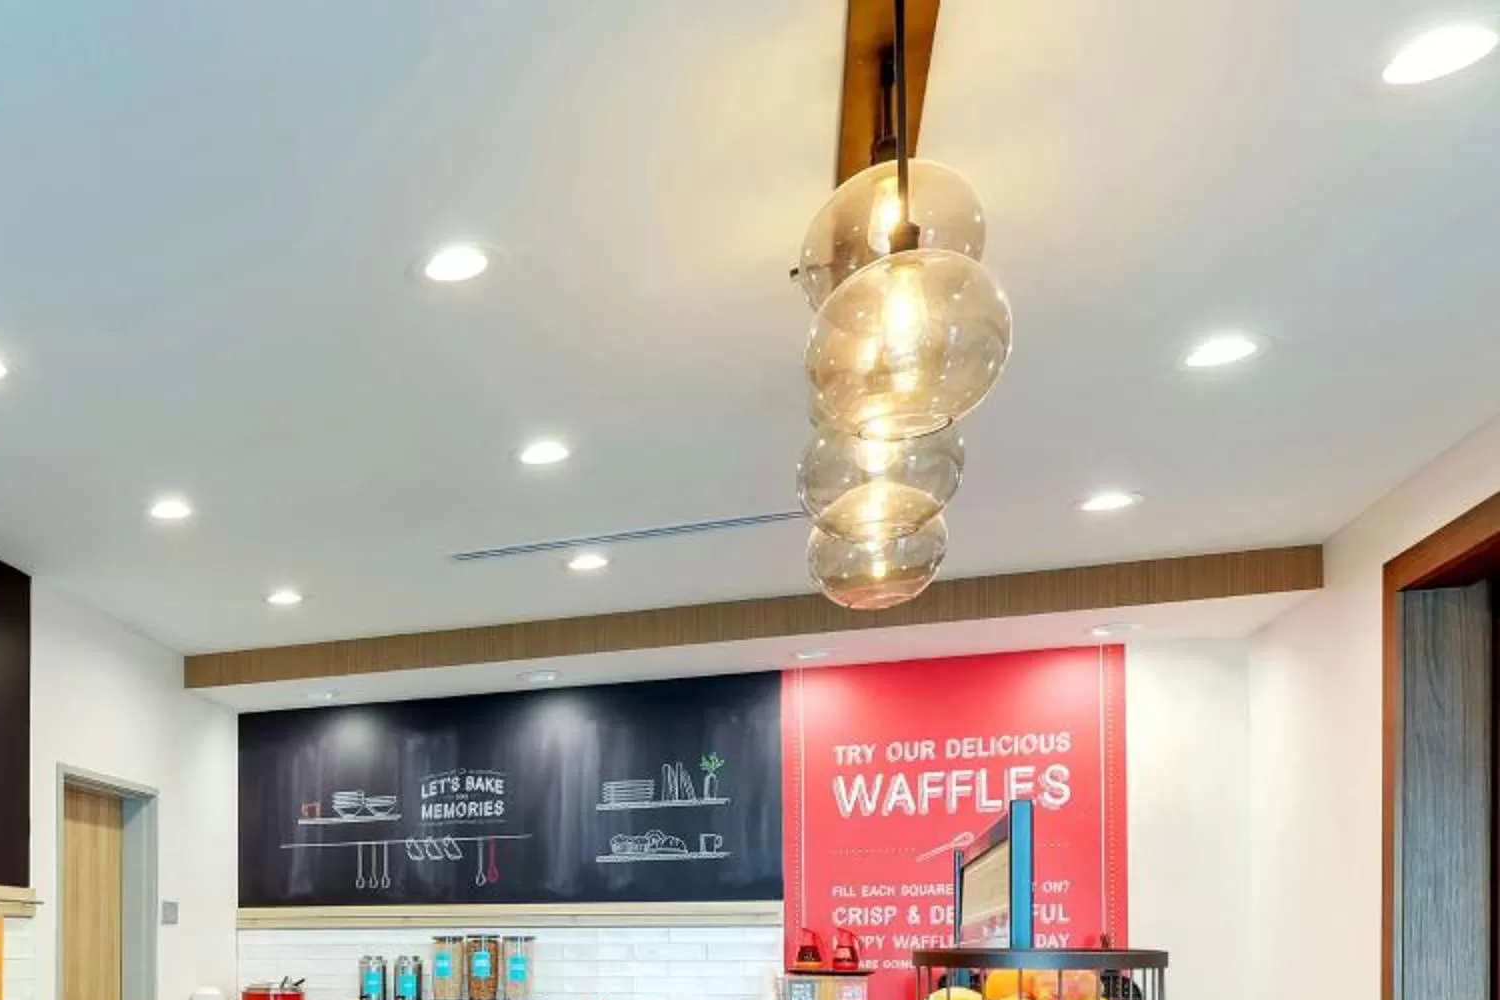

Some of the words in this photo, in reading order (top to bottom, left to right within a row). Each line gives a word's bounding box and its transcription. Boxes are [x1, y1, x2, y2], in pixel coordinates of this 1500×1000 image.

[833, 743, 877, 766] TRY
[886, 739, 936, 763] OUR
[944, 731, 1072, 760] DELICIOUS
[421, 775, 461, 799] LET'S
[465, 775, 505, 796] BAKE
[832, 763, 1072, 818] WAFFLES
[421, 799, 505, 820] MEMORIES
[832, 885, 857, 897] FILL
[861, 884, 896, 897] EACH
[832, 904, 898, 926] CRISP
[908, 904, 921, 925] &
[1034, 931, 1071, 949] DAY
